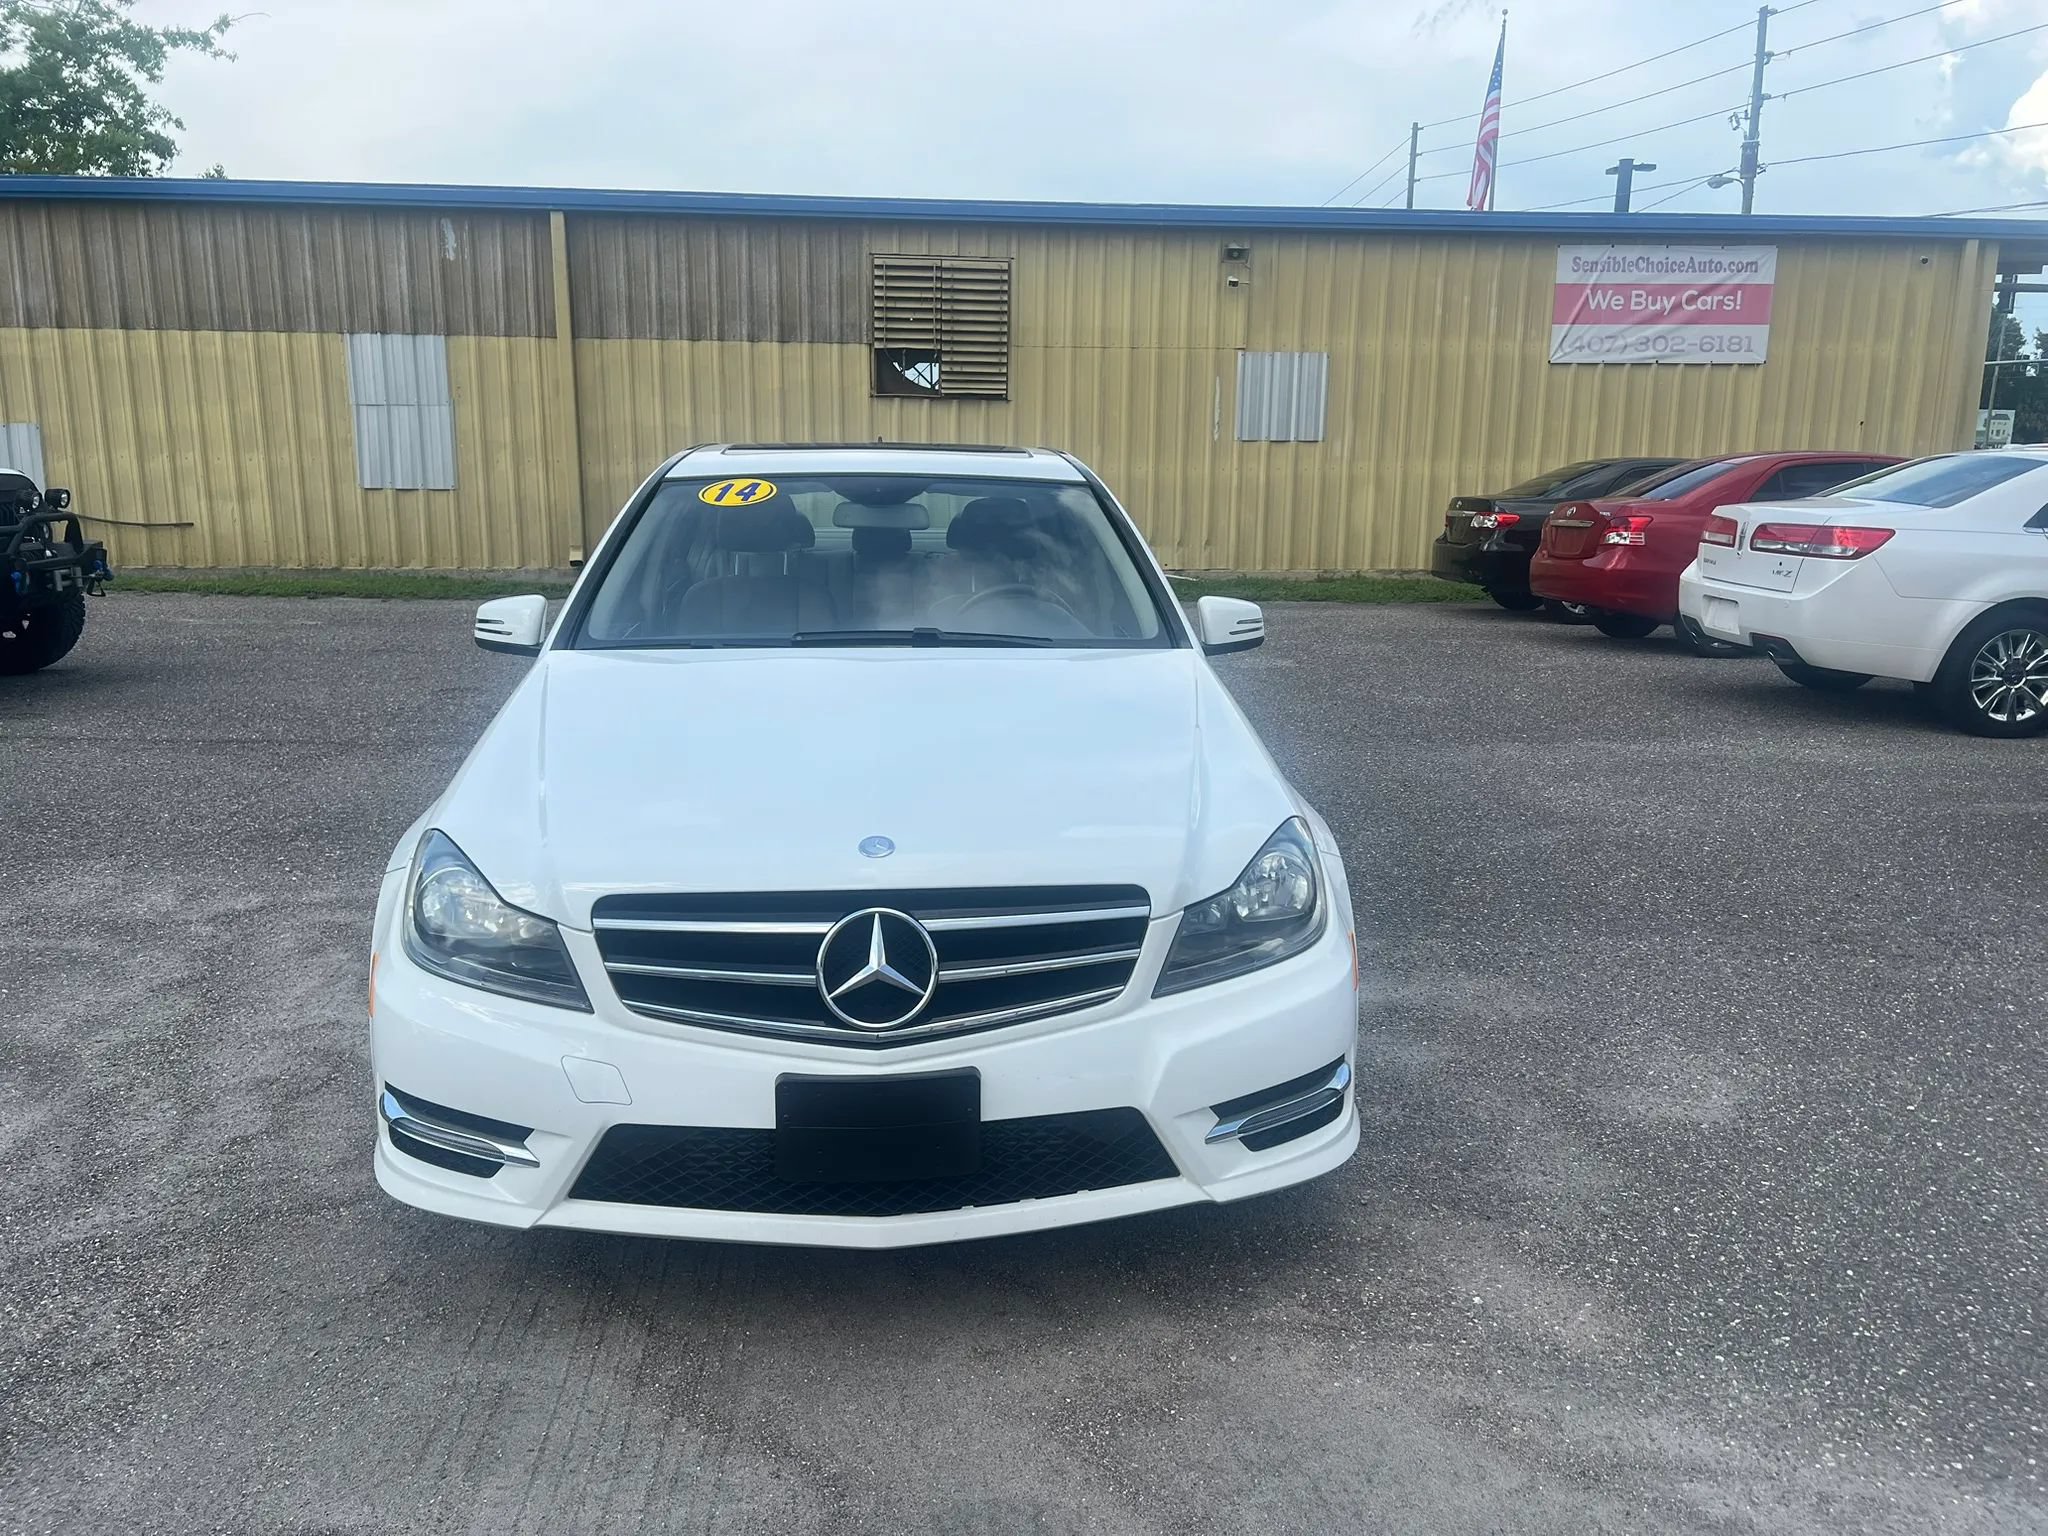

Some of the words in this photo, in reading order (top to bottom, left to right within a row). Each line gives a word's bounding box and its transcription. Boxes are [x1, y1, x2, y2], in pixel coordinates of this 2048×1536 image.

[1571, 255, 1759, 273] SensibleChoiceAuto.com
[1587, 289, 1624, 310] We
[1630, 290, 1676, 315] Buy
[1681, 289, 1743, 311] Cars!
[1634, 335, 1753, 353] 302-6181
[714, 482, 761, 502] 14
